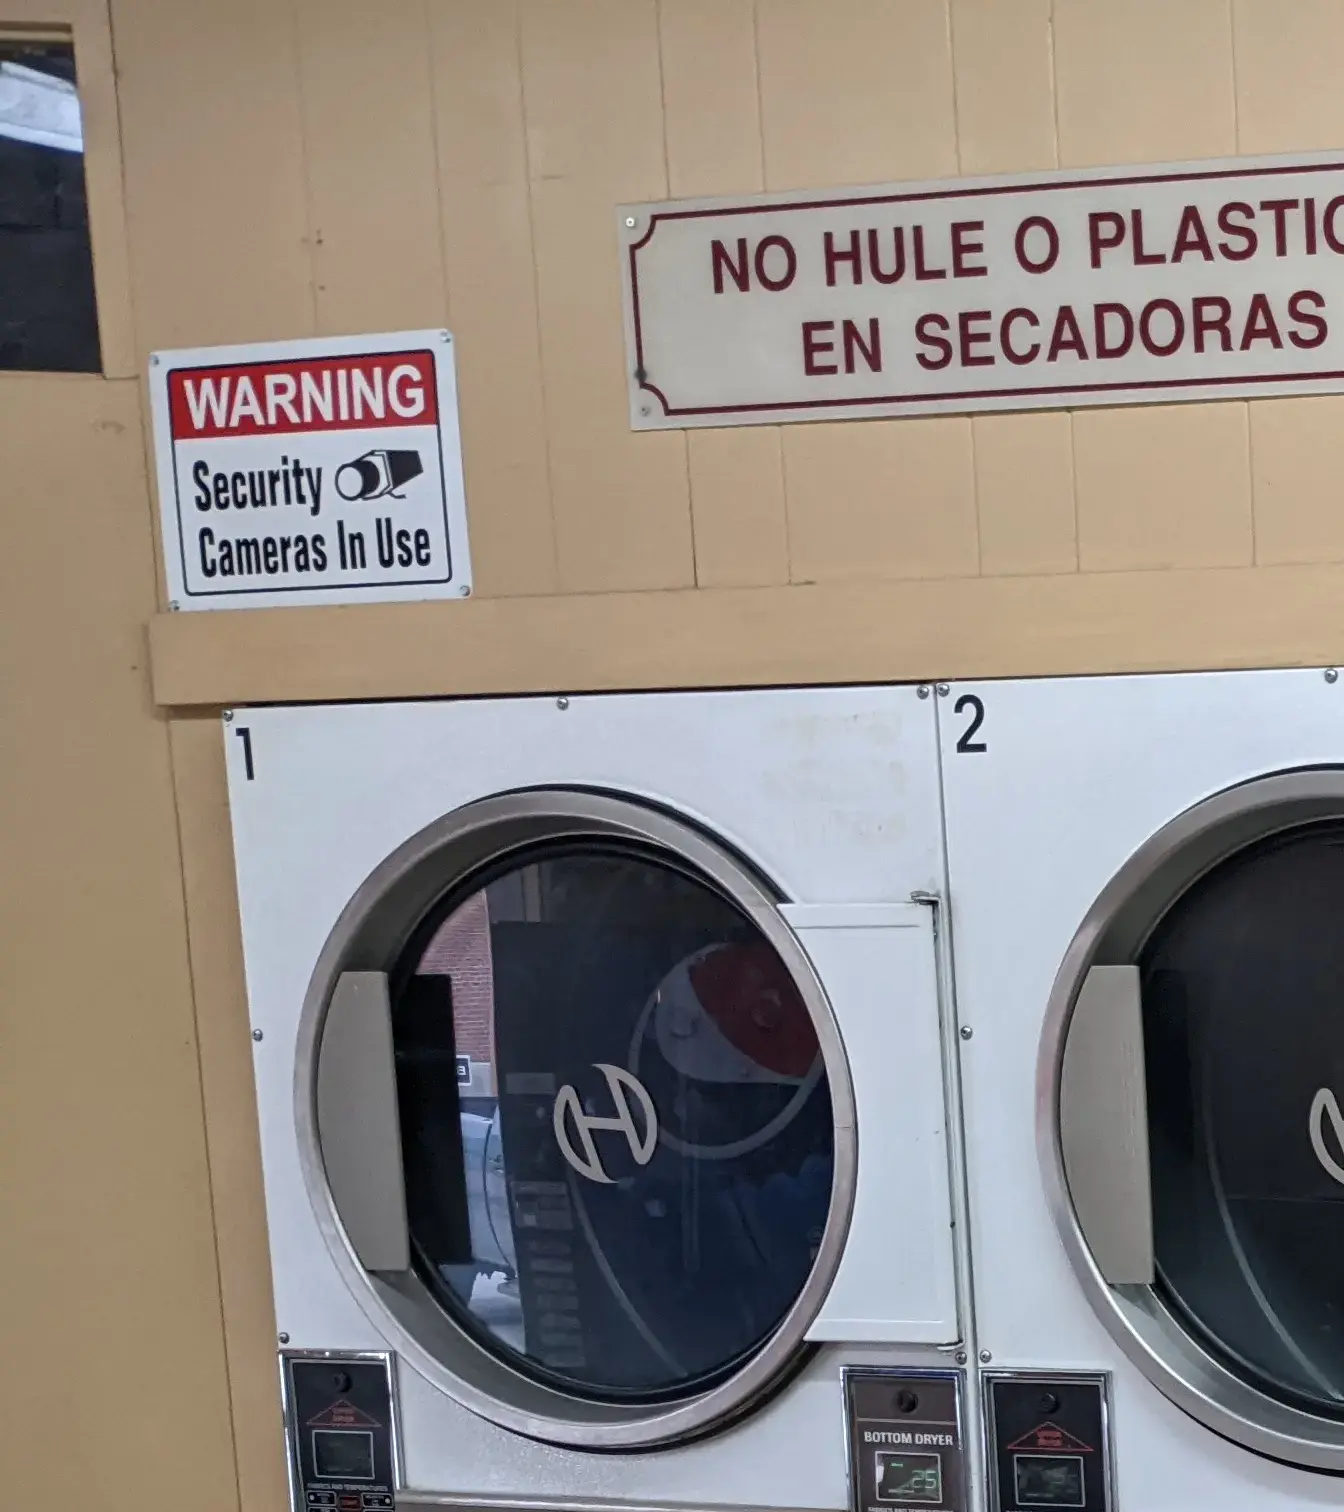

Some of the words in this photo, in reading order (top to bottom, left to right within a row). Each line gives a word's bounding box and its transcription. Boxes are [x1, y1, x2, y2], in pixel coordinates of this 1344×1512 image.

[711, 235, 797, 294] NO
[824, 221, 988, 287] HULE
[1015, 216, 1059, 274] O
[802, 318, 883, 377] EN
[915, 290, 1329, 371] SECADORAS
[184, 365, 425, 430] WARNING
[193, 456, 322, 516] Security
[199, 527, 328, 578] Cameras
[337, 520, 367, 570] In
[376, 517, 431, 568] Use
[955, 694, 986, 753] 2
[236, 728, 254, 780] 1
[864, 1431, 912, 1444] BOTTOM
[914, 1433, 953, 1446] DRYER
